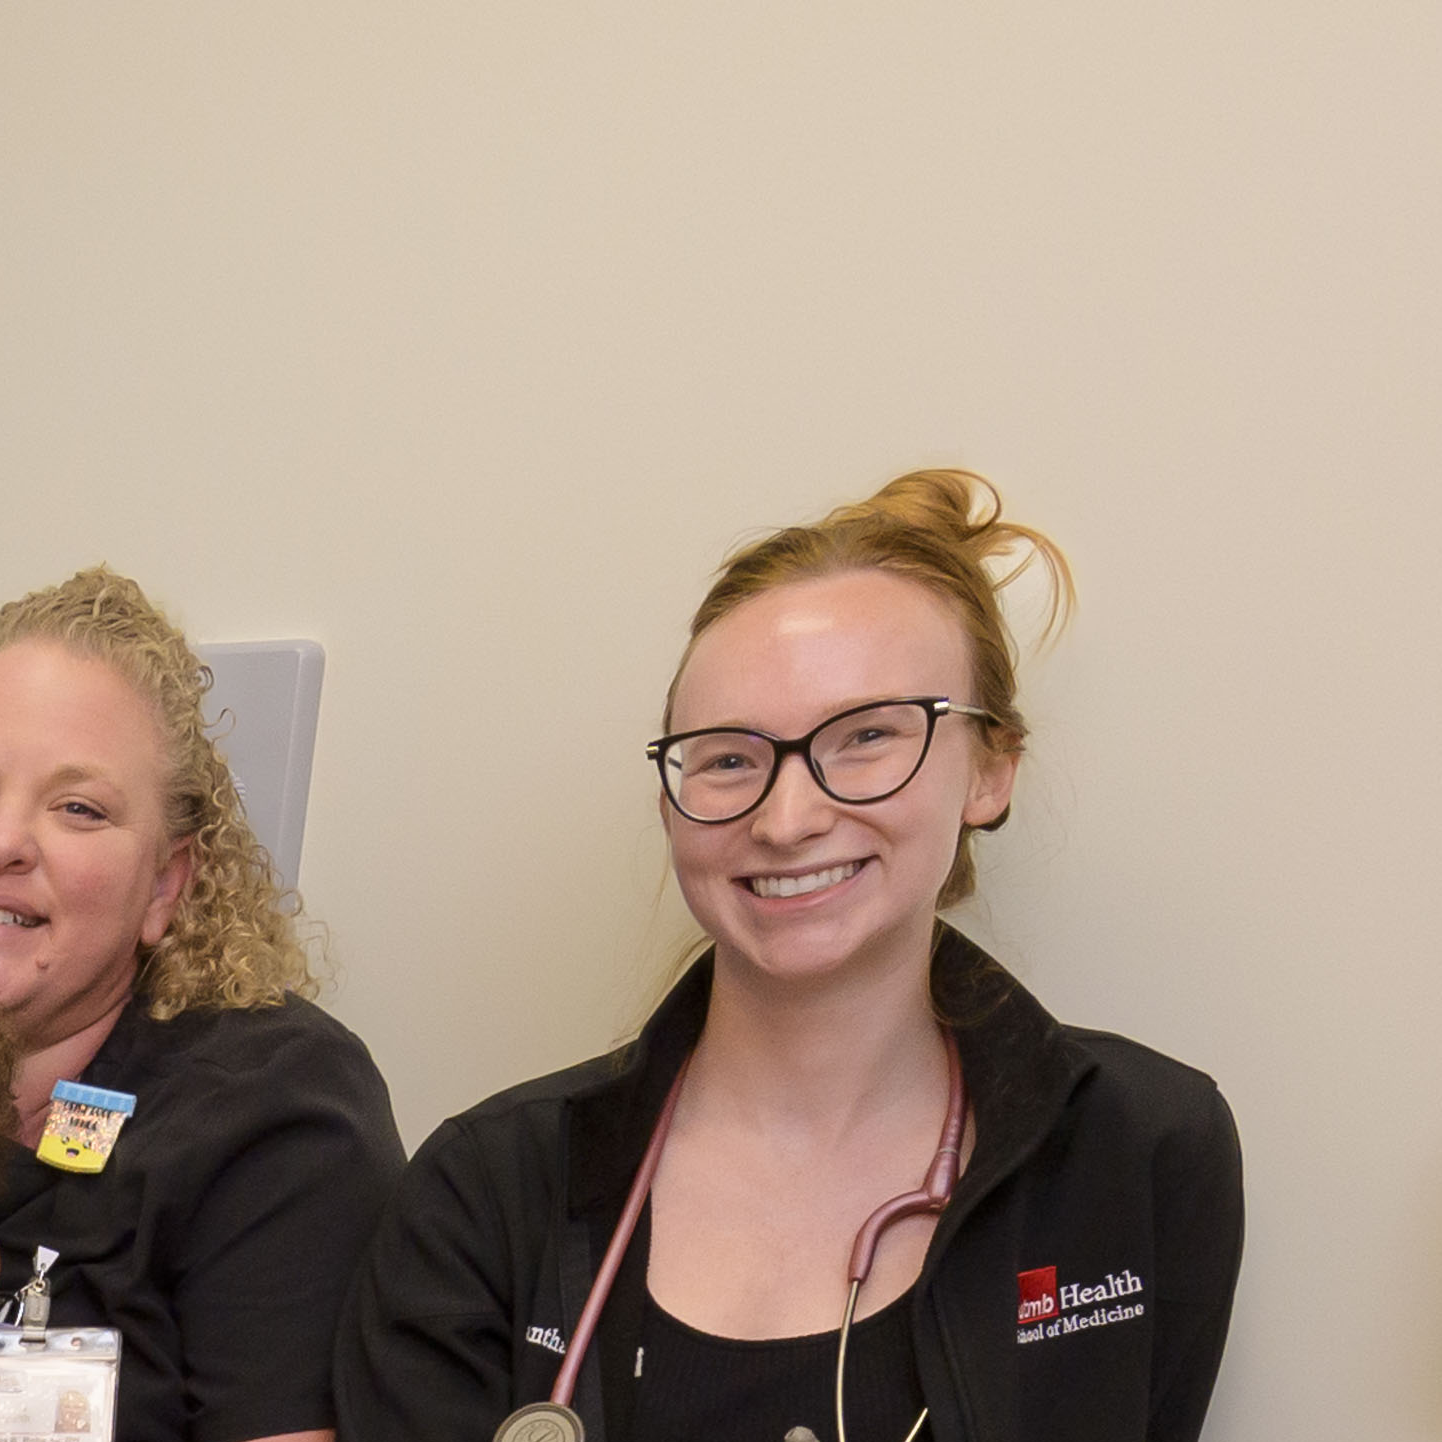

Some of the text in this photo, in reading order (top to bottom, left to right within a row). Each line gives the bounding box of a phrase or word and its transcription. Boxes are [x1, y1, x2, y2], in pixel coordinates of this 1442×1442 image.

[1060, 1269, 1144, 1310] Health
[1046, 1318, 1063, 1338] of
[1062, 1302, 1145, 1334] Medicine
